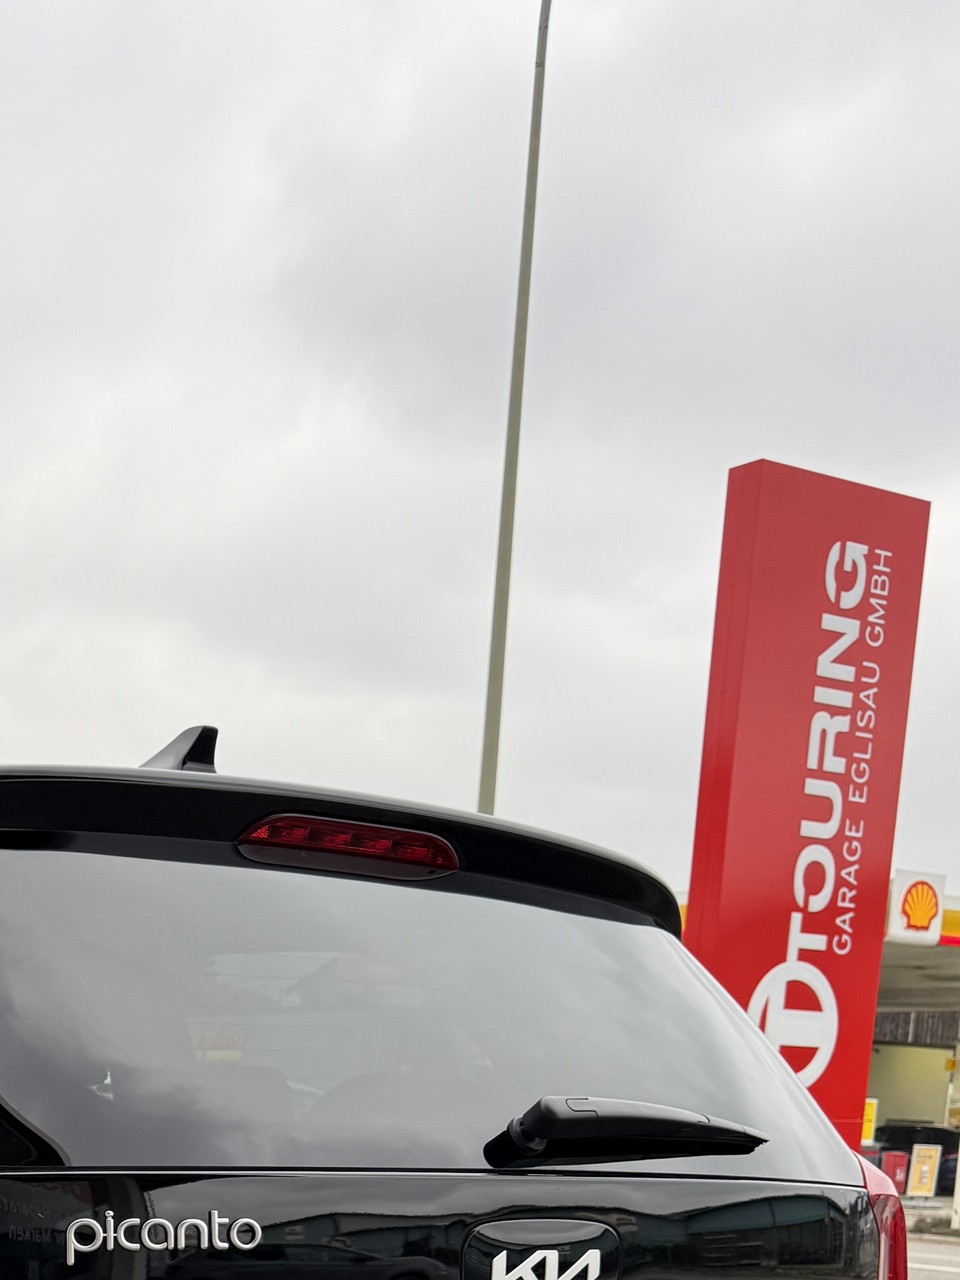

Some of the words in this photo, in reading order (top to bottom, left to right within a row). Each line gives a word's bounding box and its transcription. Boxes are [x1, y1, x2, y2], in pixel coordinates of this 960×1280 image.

[865, 549, 892, 647] GMBH
[786, 541, 869, 962] TOURING
[848, 661, 881, 803] EGLISAU
[833, 819, 864, 955] GARAGE
[66, 1209, 262, 1266] picanto
